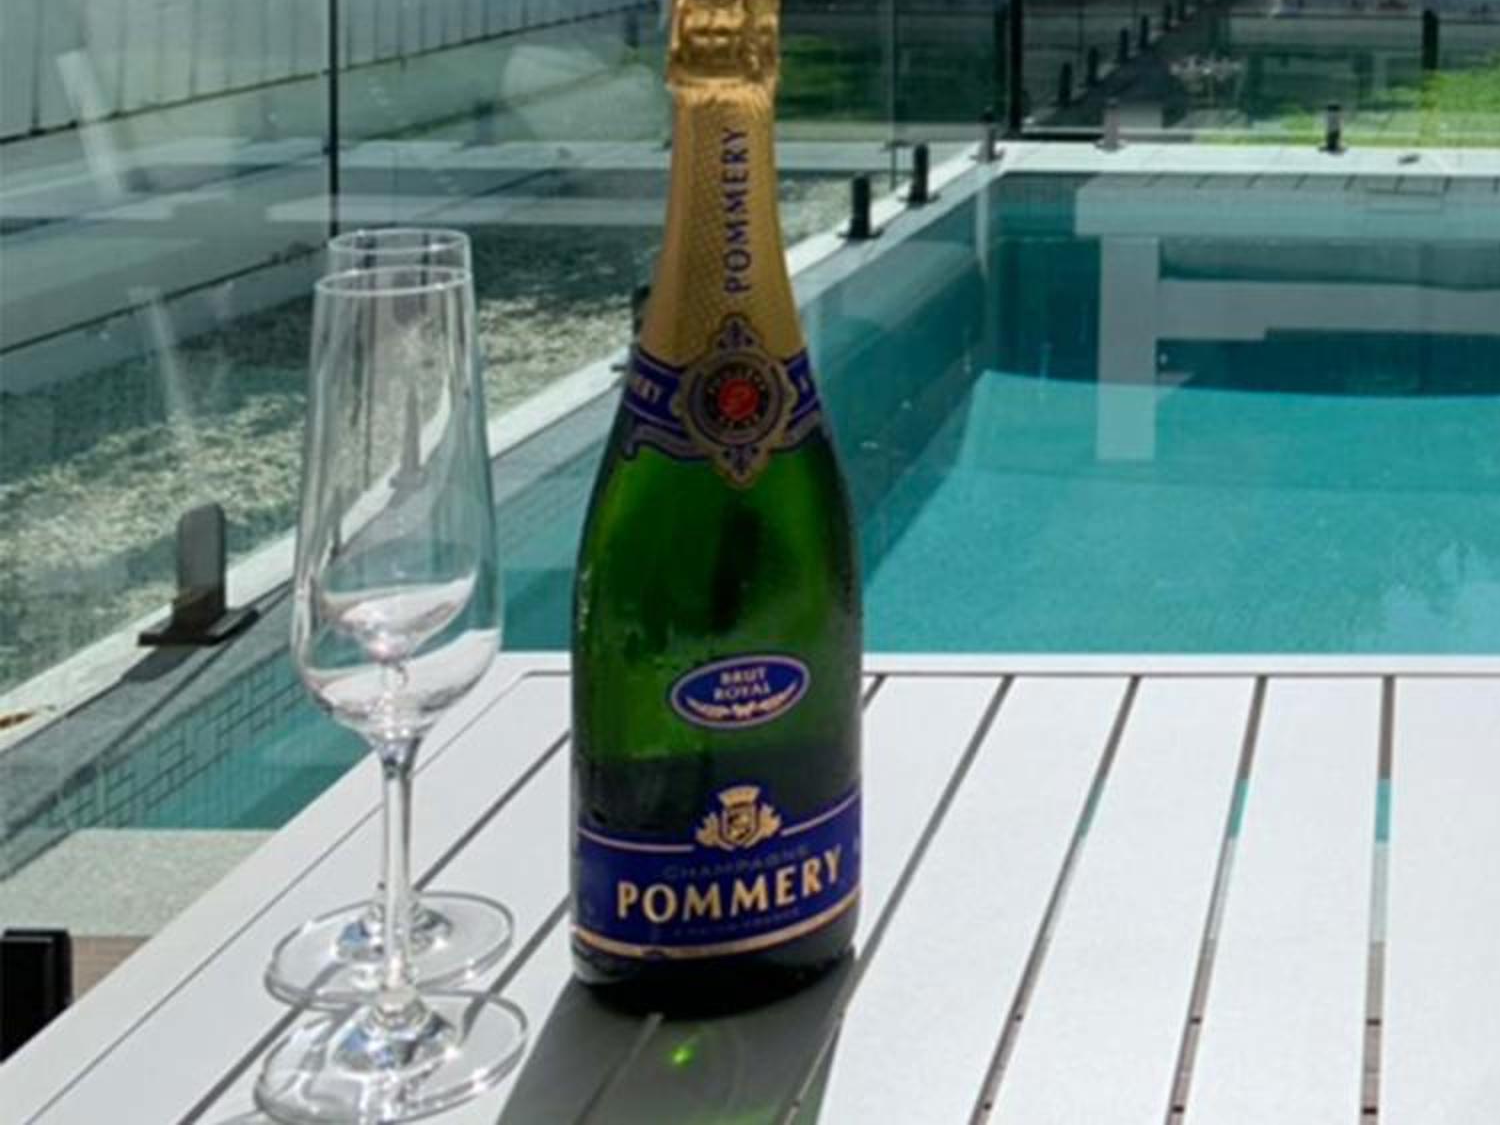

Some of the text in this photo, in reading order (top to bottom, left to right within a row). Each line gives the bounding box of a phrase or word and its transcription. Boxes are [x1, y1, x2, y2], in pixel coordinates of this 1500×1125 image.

[721, 125, 753, 295] POMMERY
[713, 681, 772, 701] ROYAL
[720, 666, 767, 686] BRUT
[616, 843, 843, 923] POMMERY
